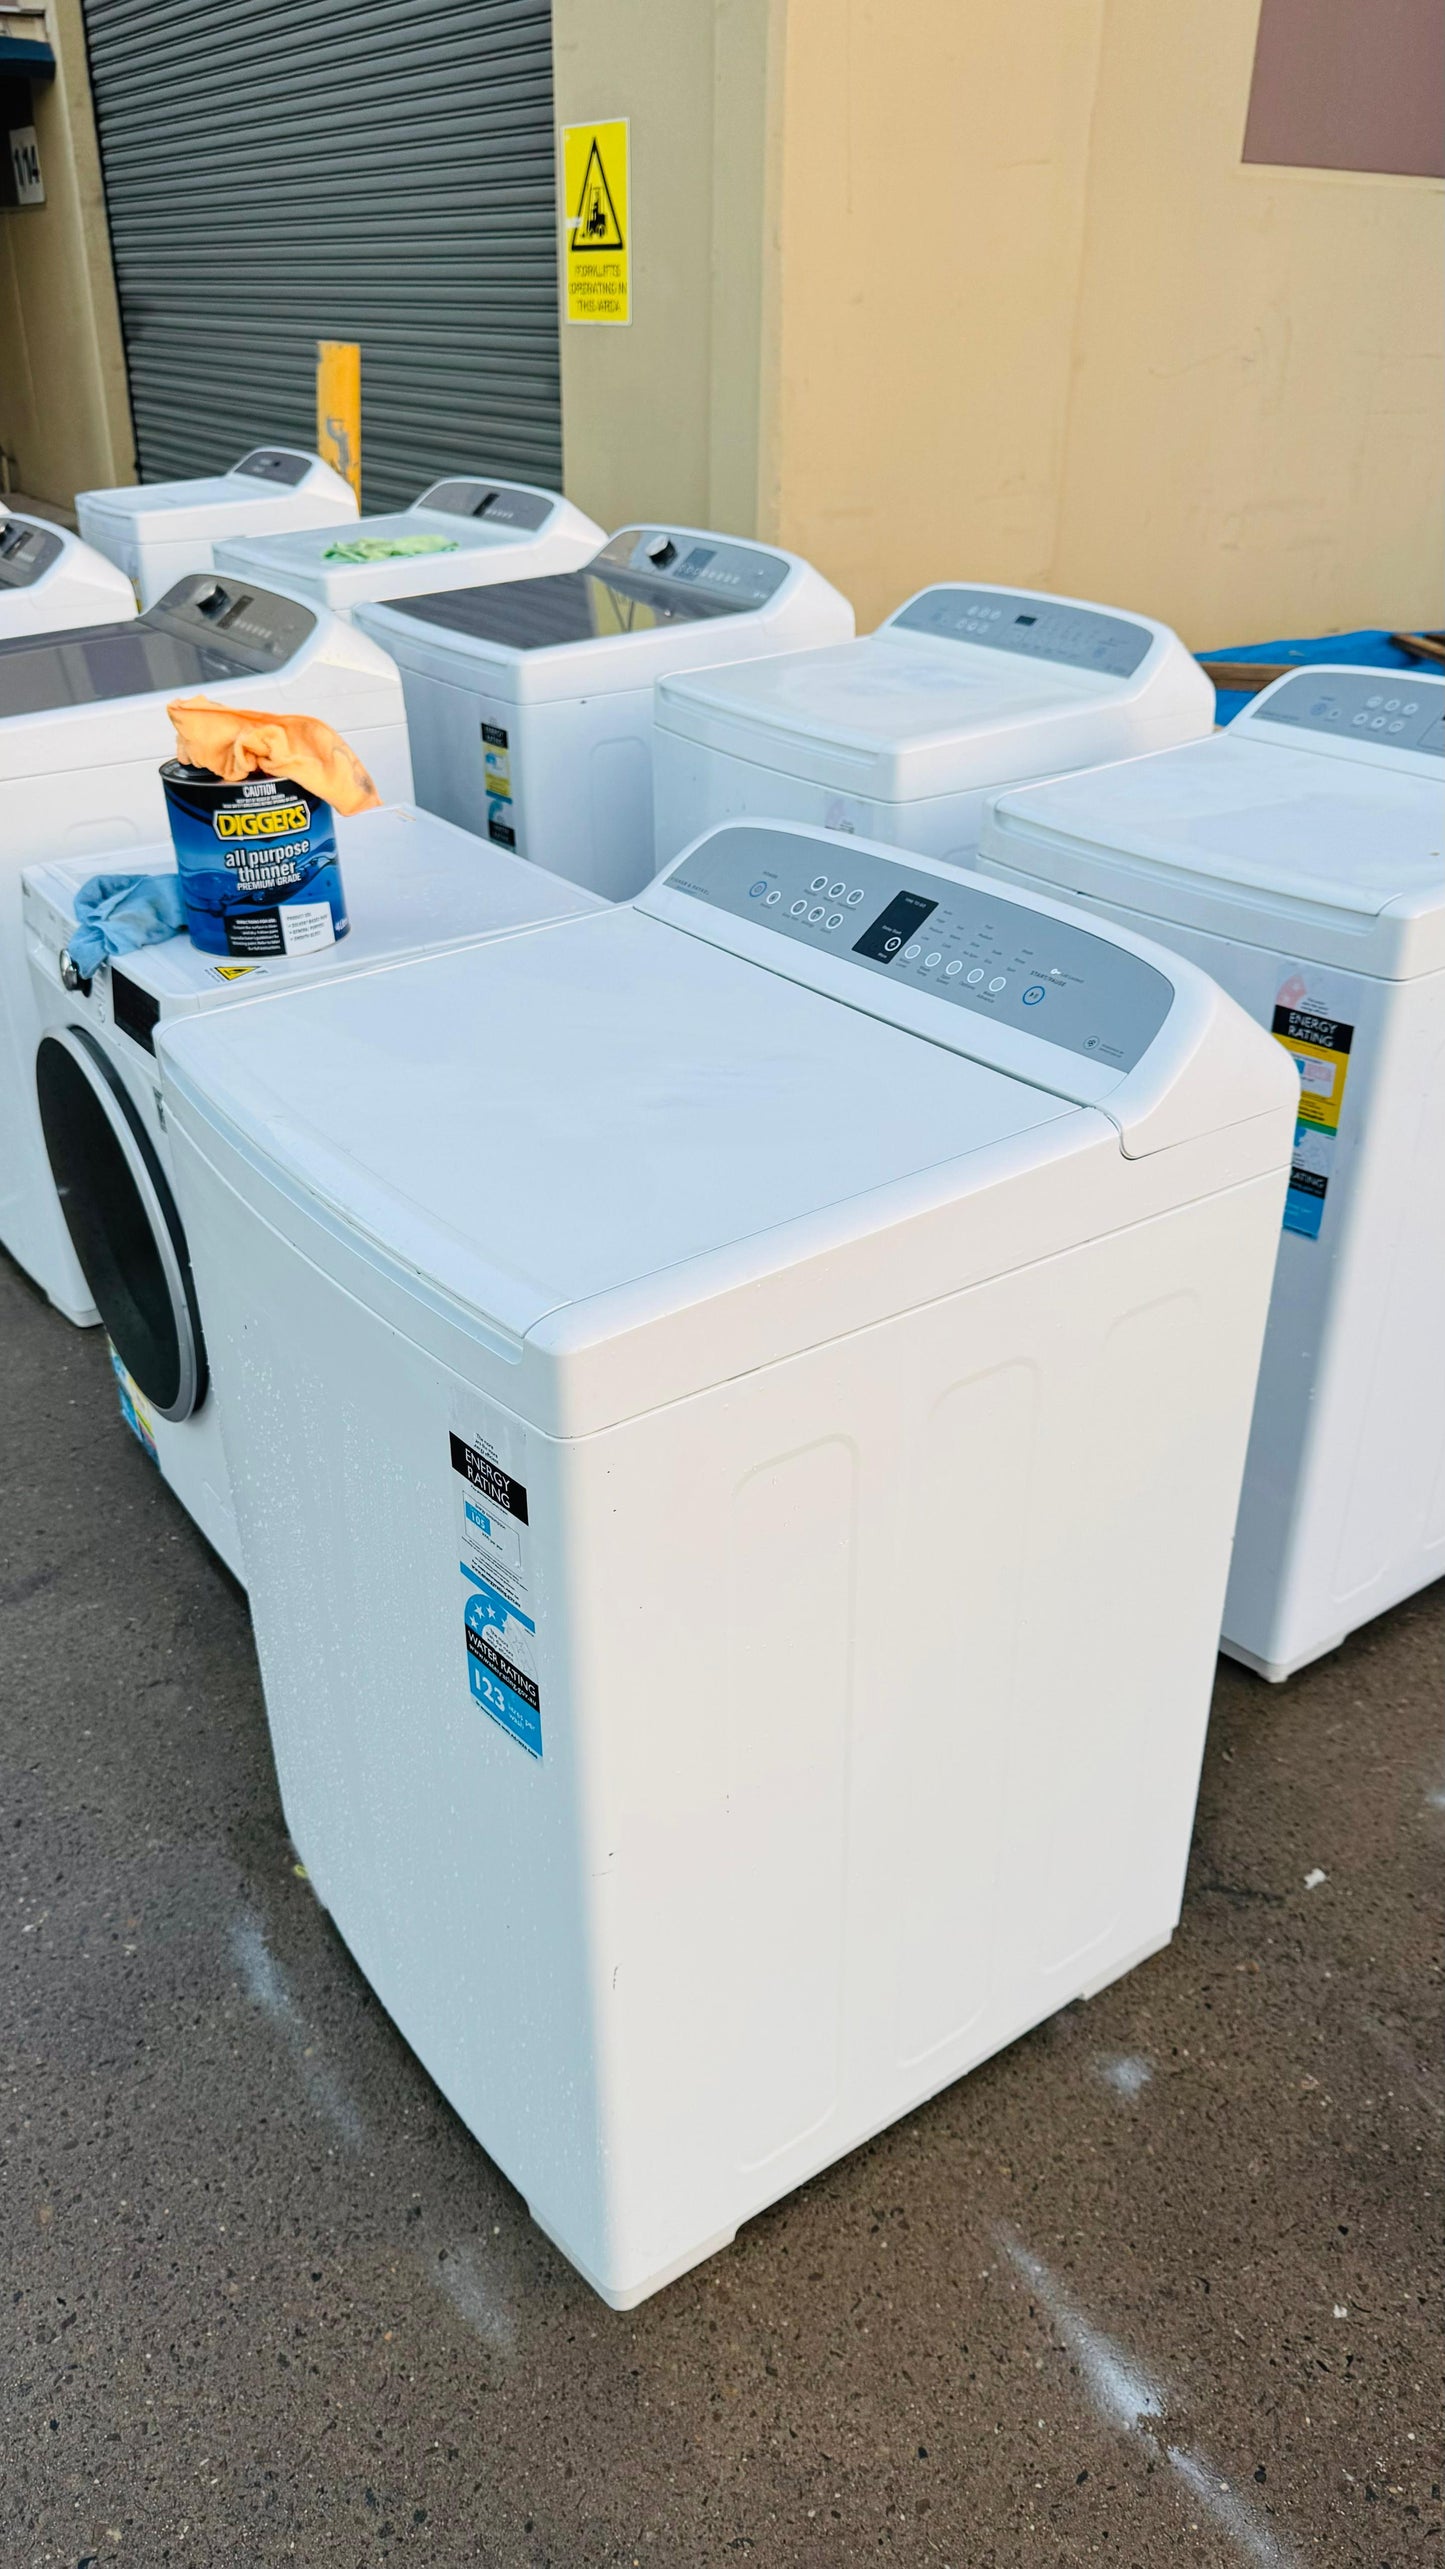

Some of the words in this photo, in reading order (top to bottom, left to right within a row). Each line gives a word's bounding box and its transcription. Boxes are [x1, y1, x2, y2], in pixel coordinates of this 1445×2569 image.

[570, 281, 617, 295] OPERATING
[618, 281, 627, 295] IN
[243, 784, 277, 798] CAUTION
[218, 805, 307, 837] DIGGERS
[225, 850, 246, 868] all
[250, 840, 309, 867] purpose
[237, 879, 275, 891] PREMIUM
[277, 873, 301, 886] GRADE
[238, 861, 296, 883] thinner
[1288, 1012, 1338, 1034] ENERGY
[1287, 1026, 1334, 1048] RATING
[465, 1448, 510, 1492] ENERGY
[467, 1466, 511, 1509] RATING
[467, 1630, 499, 1666] WATER
[500, 1660, 536, 1697] RATING
[474, 1667, 505, 1712] 123
